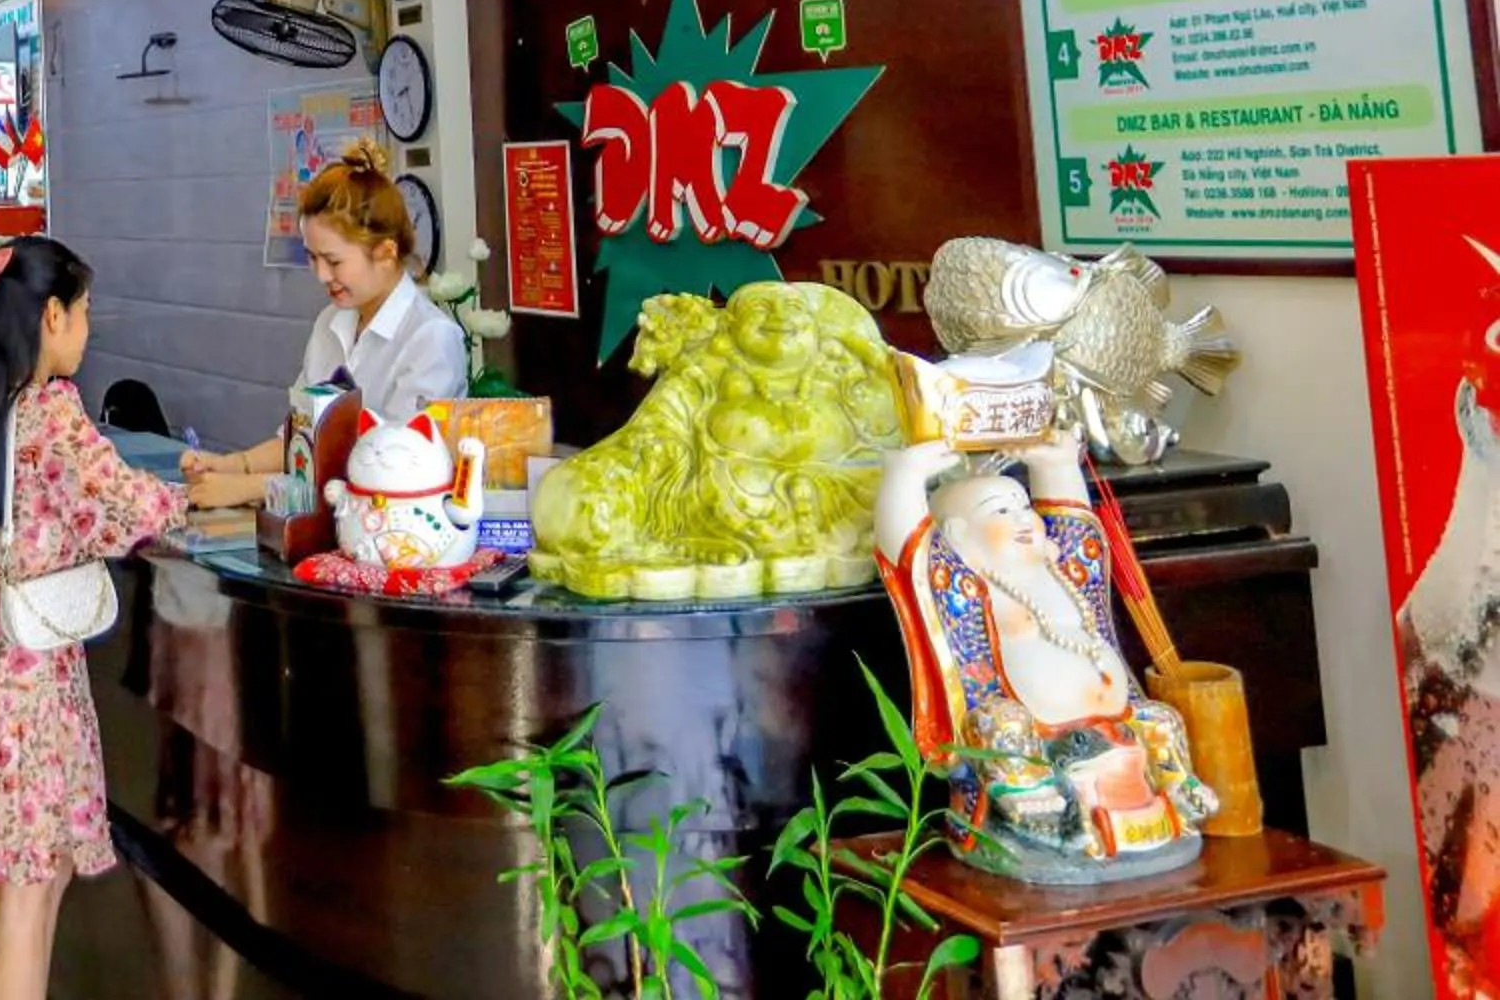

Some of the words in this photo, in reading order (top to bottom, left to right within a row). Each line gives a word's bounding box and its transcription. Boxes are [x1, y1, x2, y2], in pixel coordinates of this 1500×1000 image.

[1057, 42, 1069, 66] 4
[1096, 30, 1142, 62] DMZ
[1116, 114, 1147, 132] DMZ
[1150, 112, 1178, 130] BAR
[1184, 111, 1194, 129] &
[1199, 105, 1303, 128] RESTAURANT
[1318, 98, 1343, 122] ĐÀ
[1346, 91, 1399, 121] NẴNG
[580, 81, 811, 250] DMZ
[1107, 159, 1153, 189] DMZ
[1274, 167, 1300, 177] Nam
[1068, 169, 1081, 193] 5
